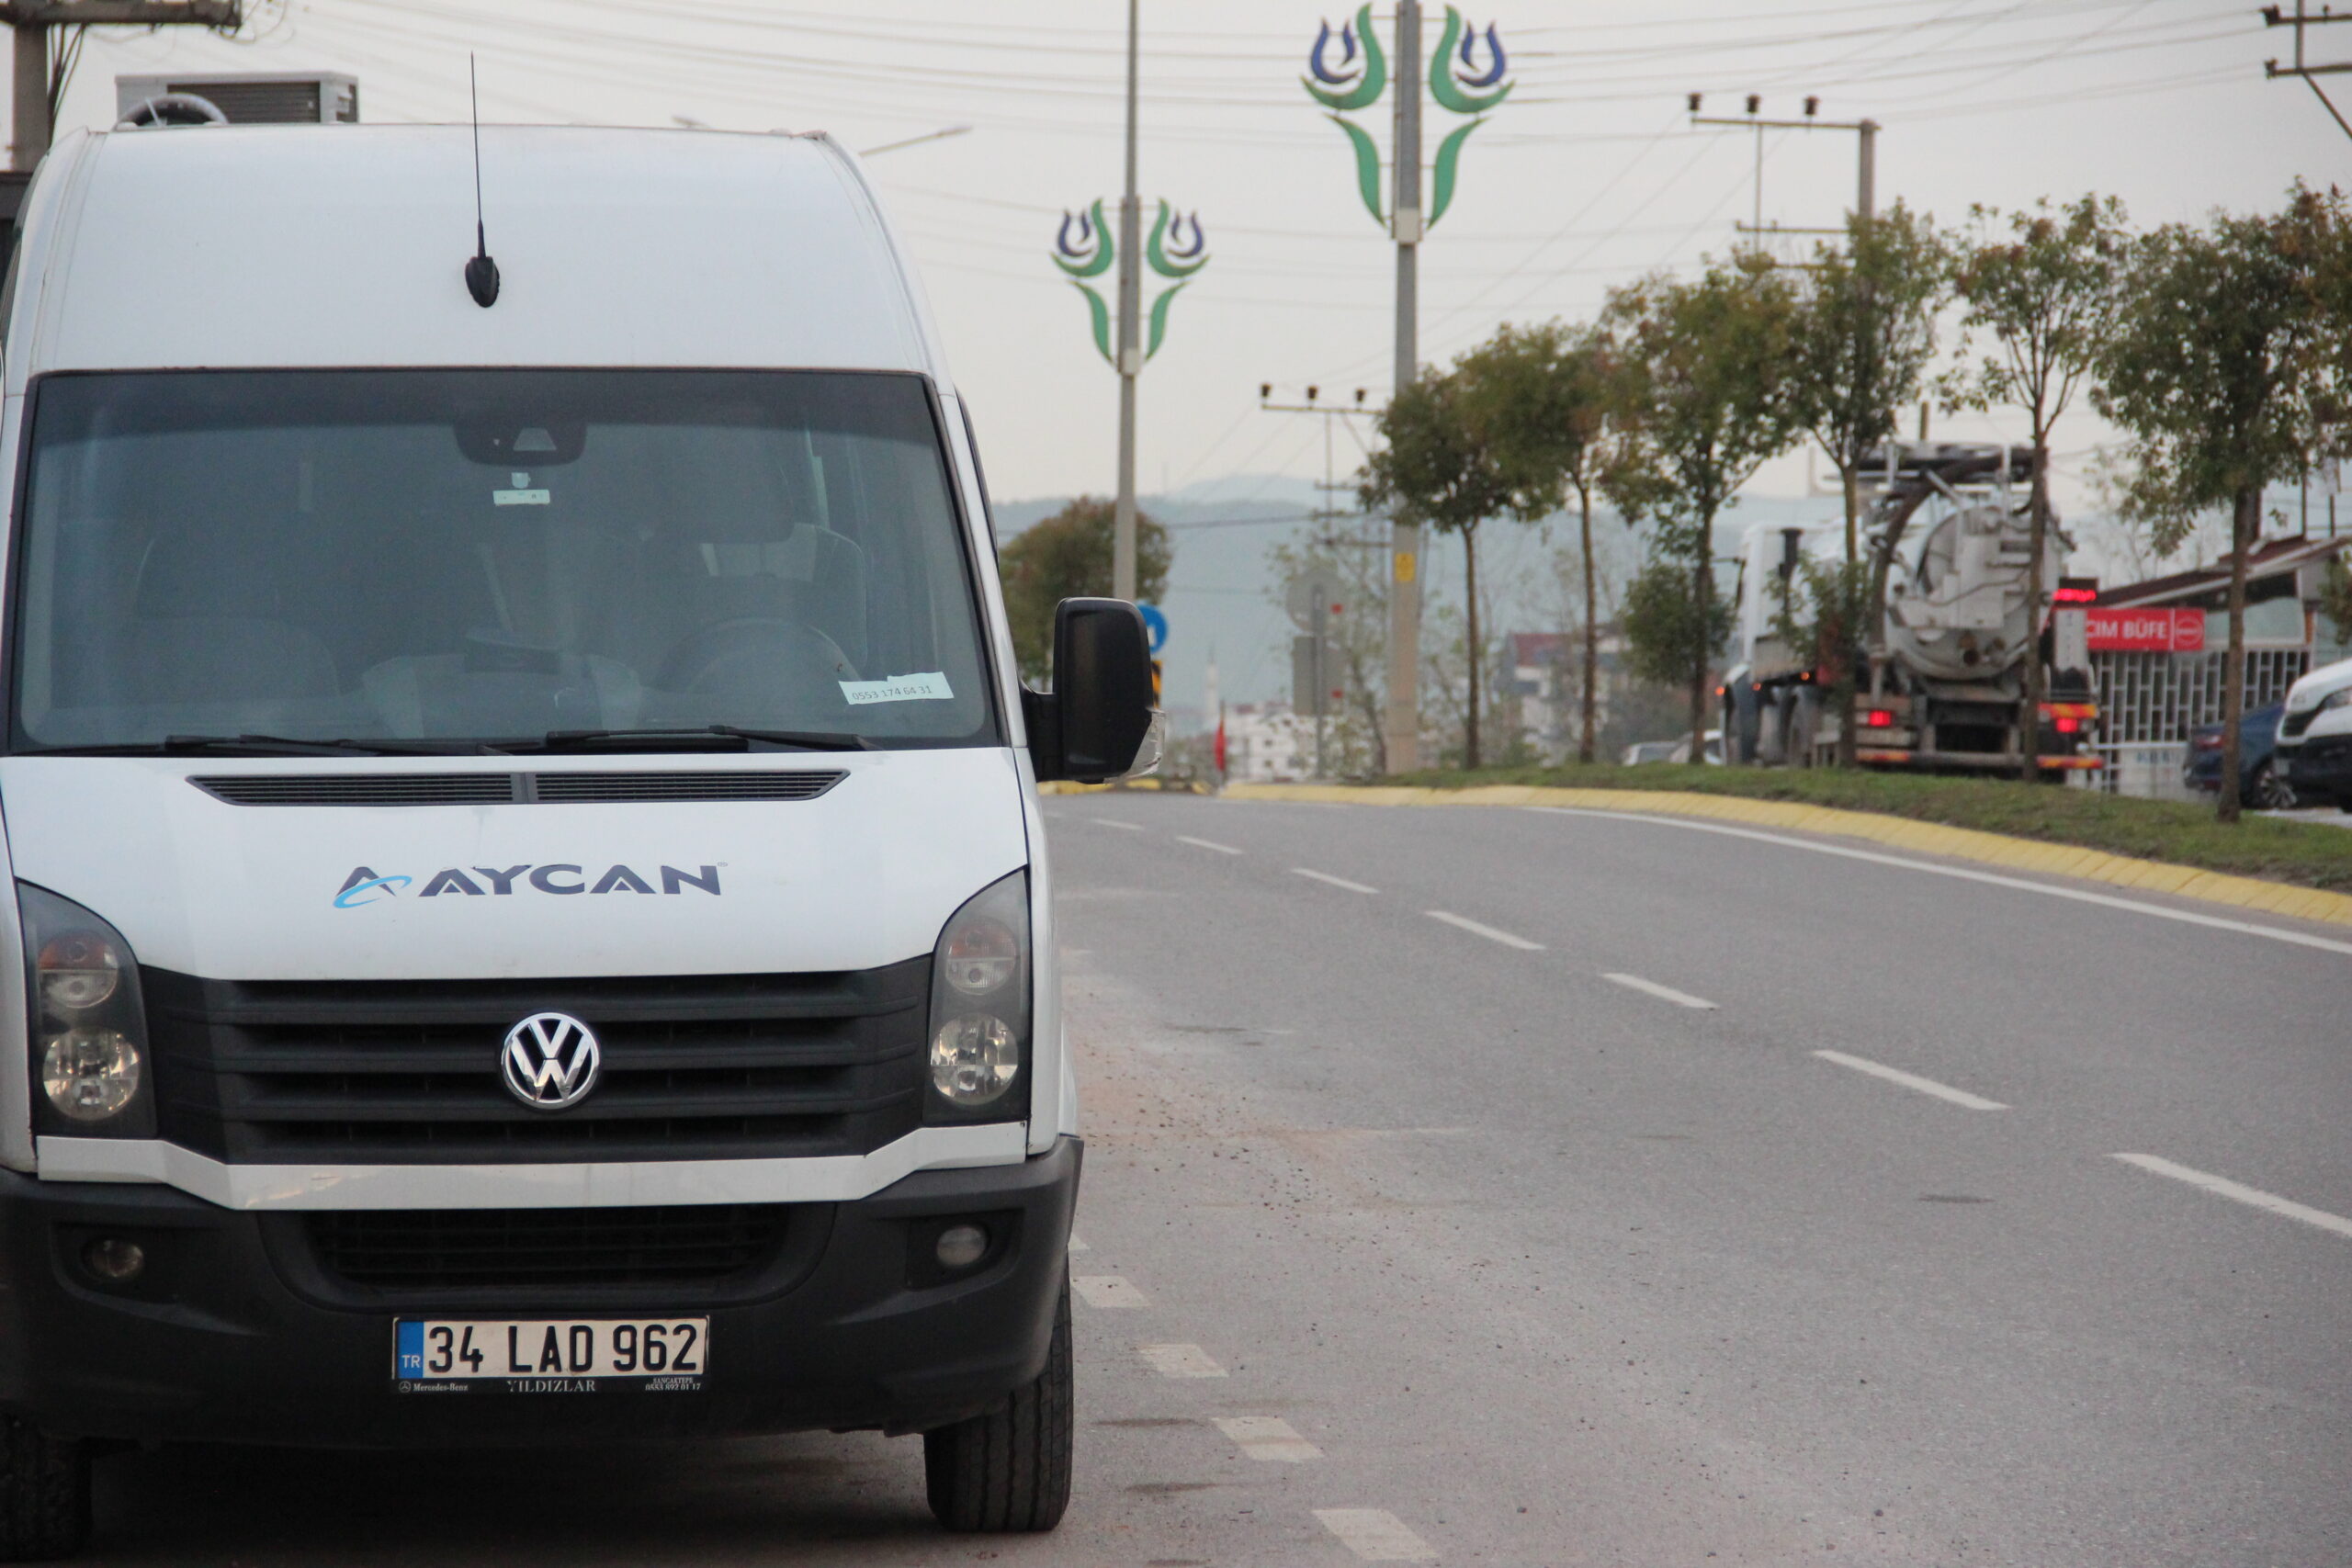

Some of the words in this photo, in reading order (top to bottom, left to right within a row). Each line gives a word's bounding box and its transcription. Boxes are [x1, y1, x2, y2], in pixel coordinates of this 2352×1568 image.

[2122, 617, 2167, 639] BÜFE
[853, 691, 878, 700] 0553
[882, 688, 900, 697] 174
[903, 686, 916, 695] 64
[919, 685, 933, 694] 31
[418, 863, 721, 897] AYCAN
[428, 1325, 484, 1372] 34
[508, 1325, 594, 1373] LAD
[613, 1324, 696, 1372] 962
[401, 1355, 421, 1368] TR
[413, 1382, 469, 1392] Mercedes-Benz
[507, 1380, 595, 1393] YILDIZLAR
